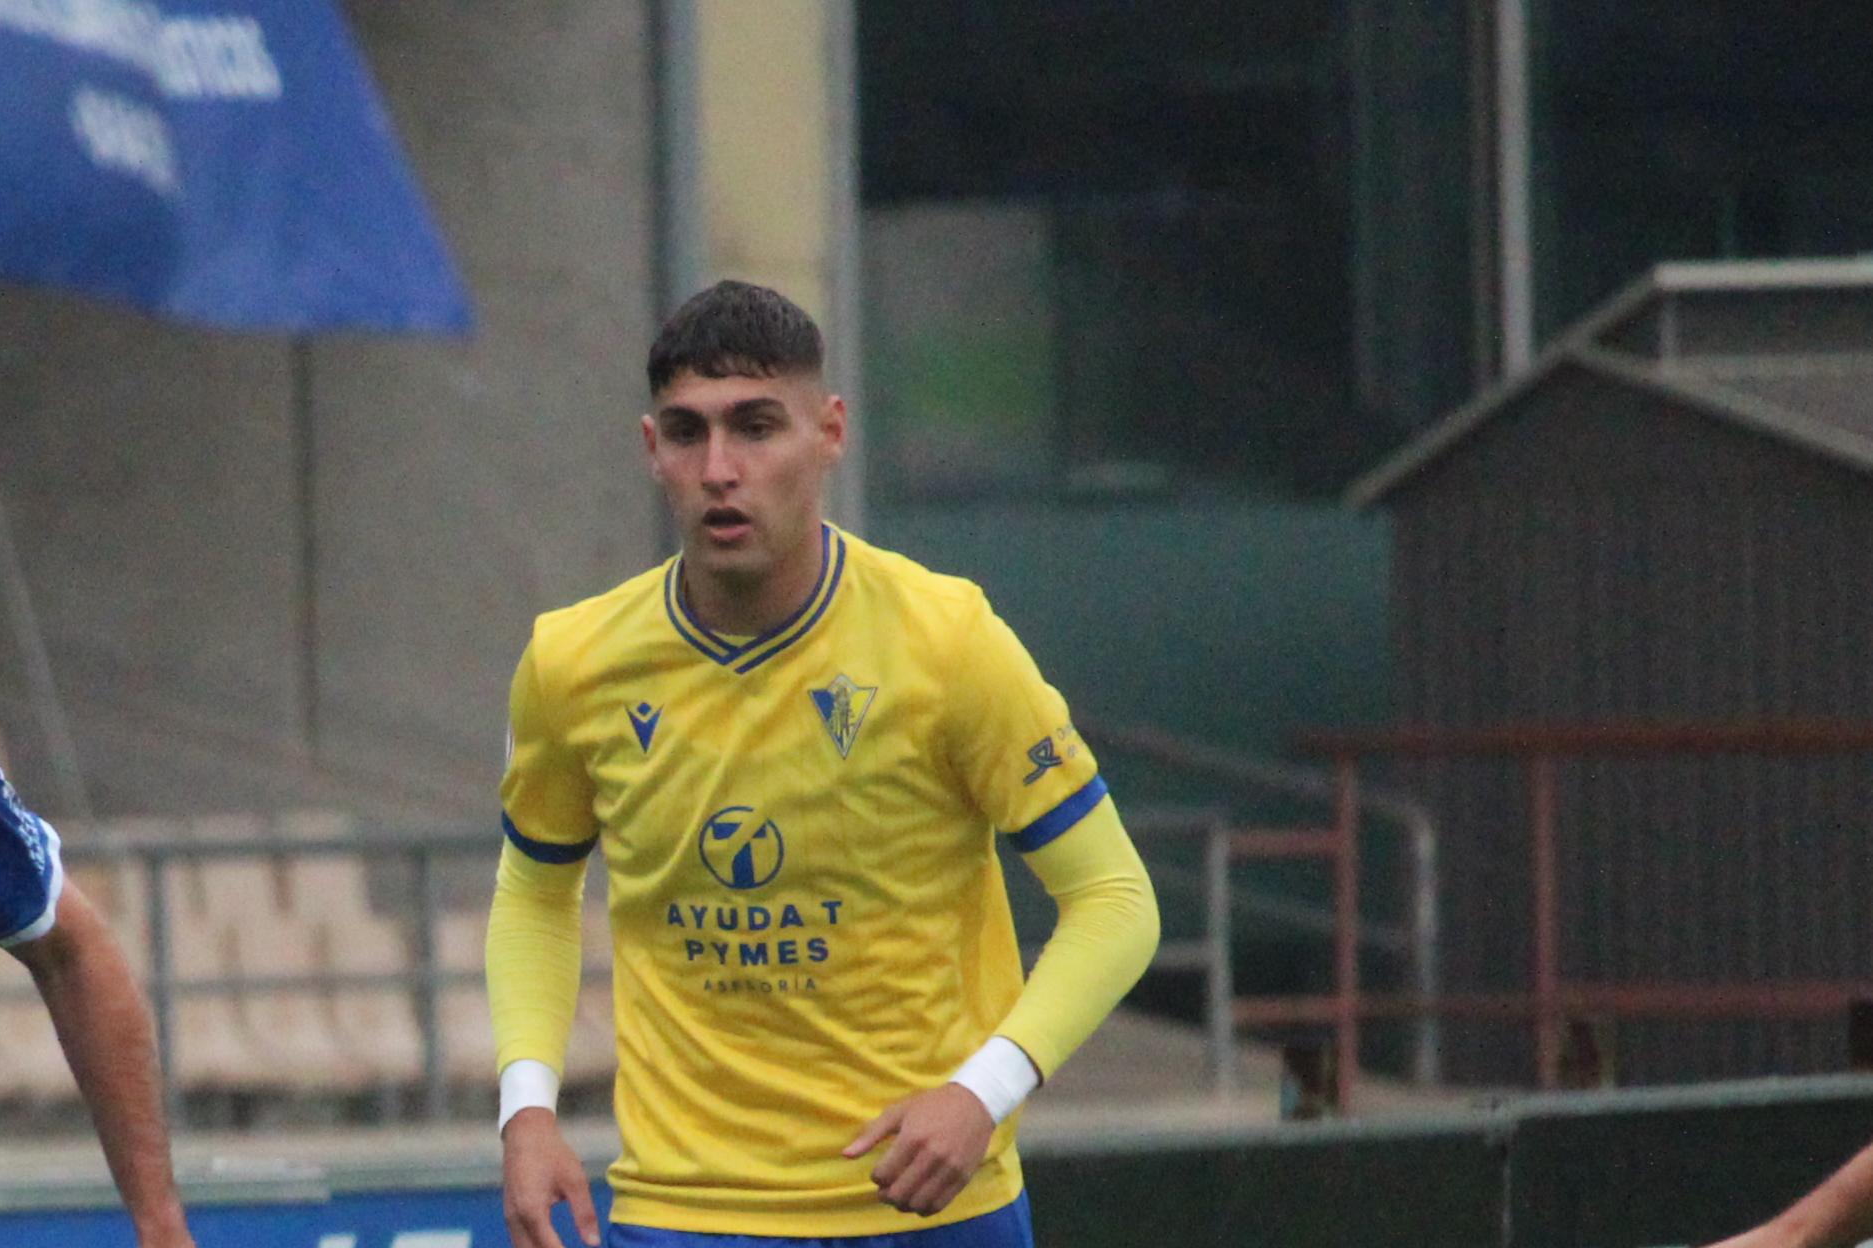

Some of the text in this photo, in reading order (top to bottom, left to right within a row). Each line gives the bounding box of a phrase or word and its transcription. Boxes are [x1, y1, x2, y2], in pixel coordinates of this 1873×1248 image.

[667, 900, 843, 931] AYUDA T
[685, 937, 829, 967] PYMES
